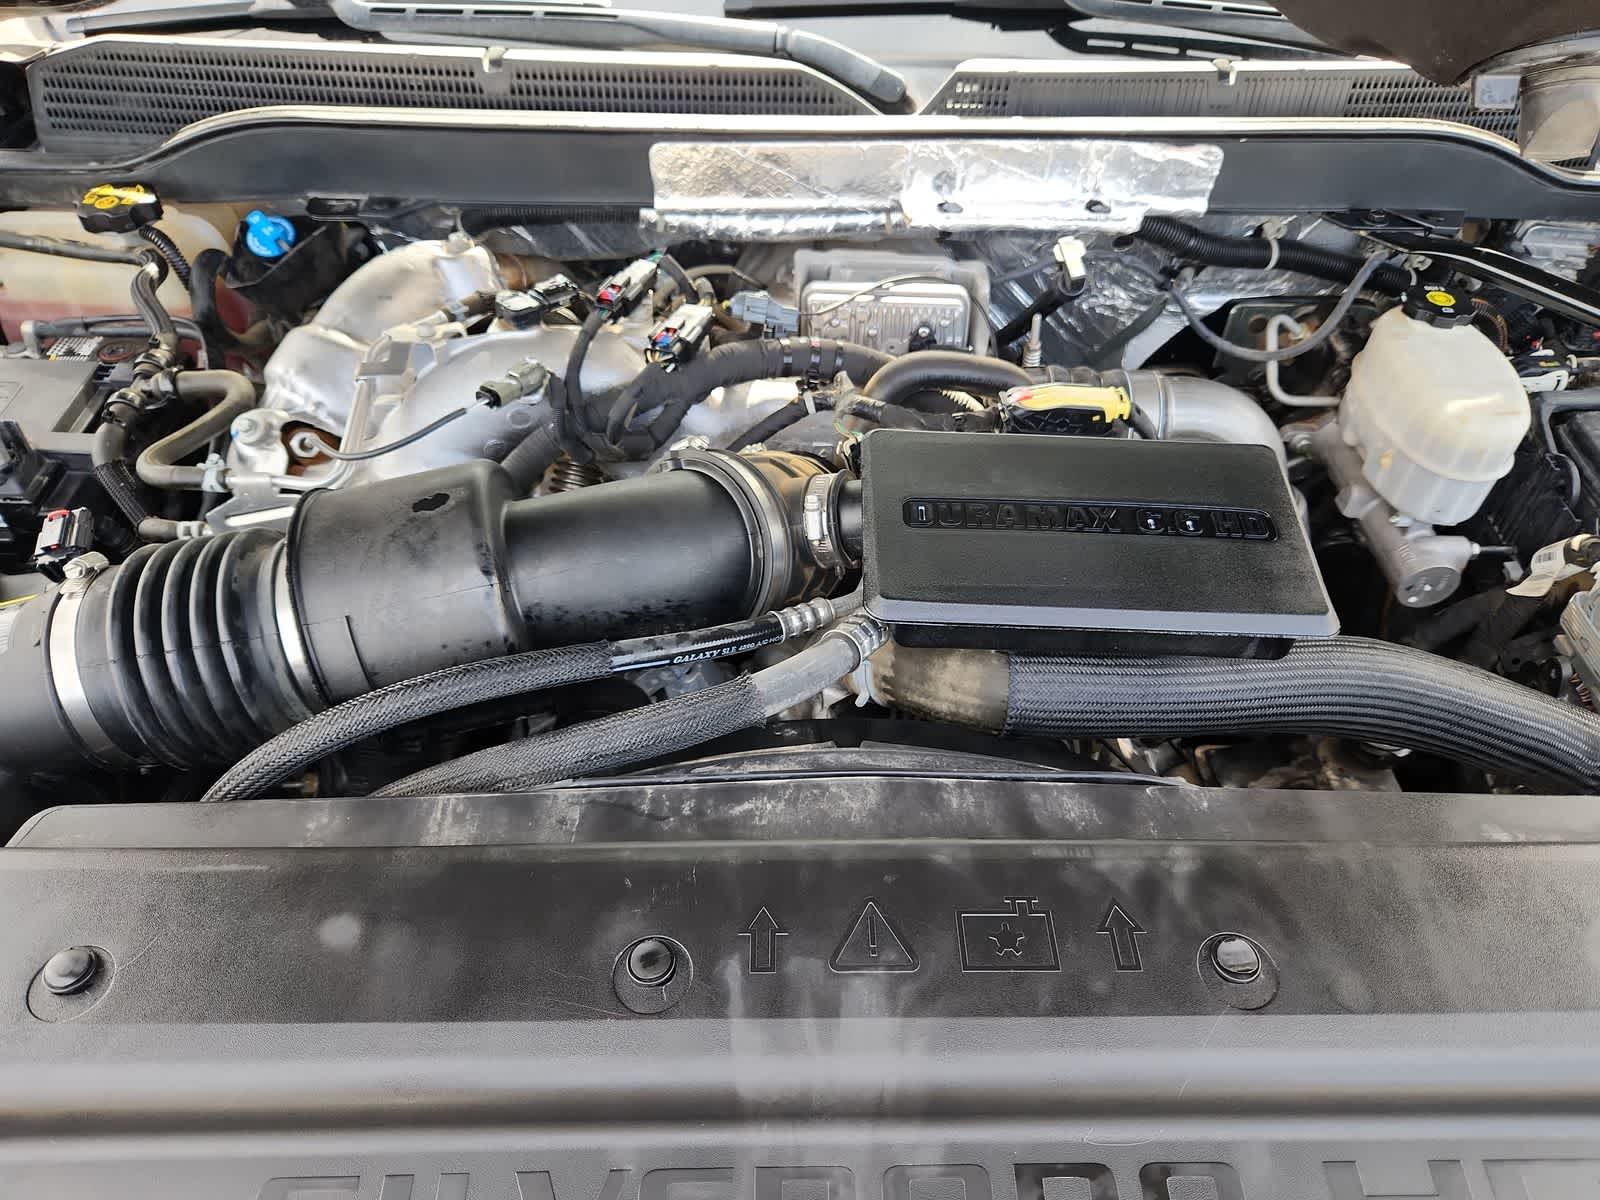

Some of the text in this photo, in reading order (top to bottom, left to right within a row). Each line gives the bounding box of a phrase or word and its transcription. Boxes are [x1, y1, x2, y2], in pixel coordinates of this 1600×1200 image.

[911, 503, 1273, 540] DURAMAX 6.6 HD
[673, 648, 721, 664] GALAXY
